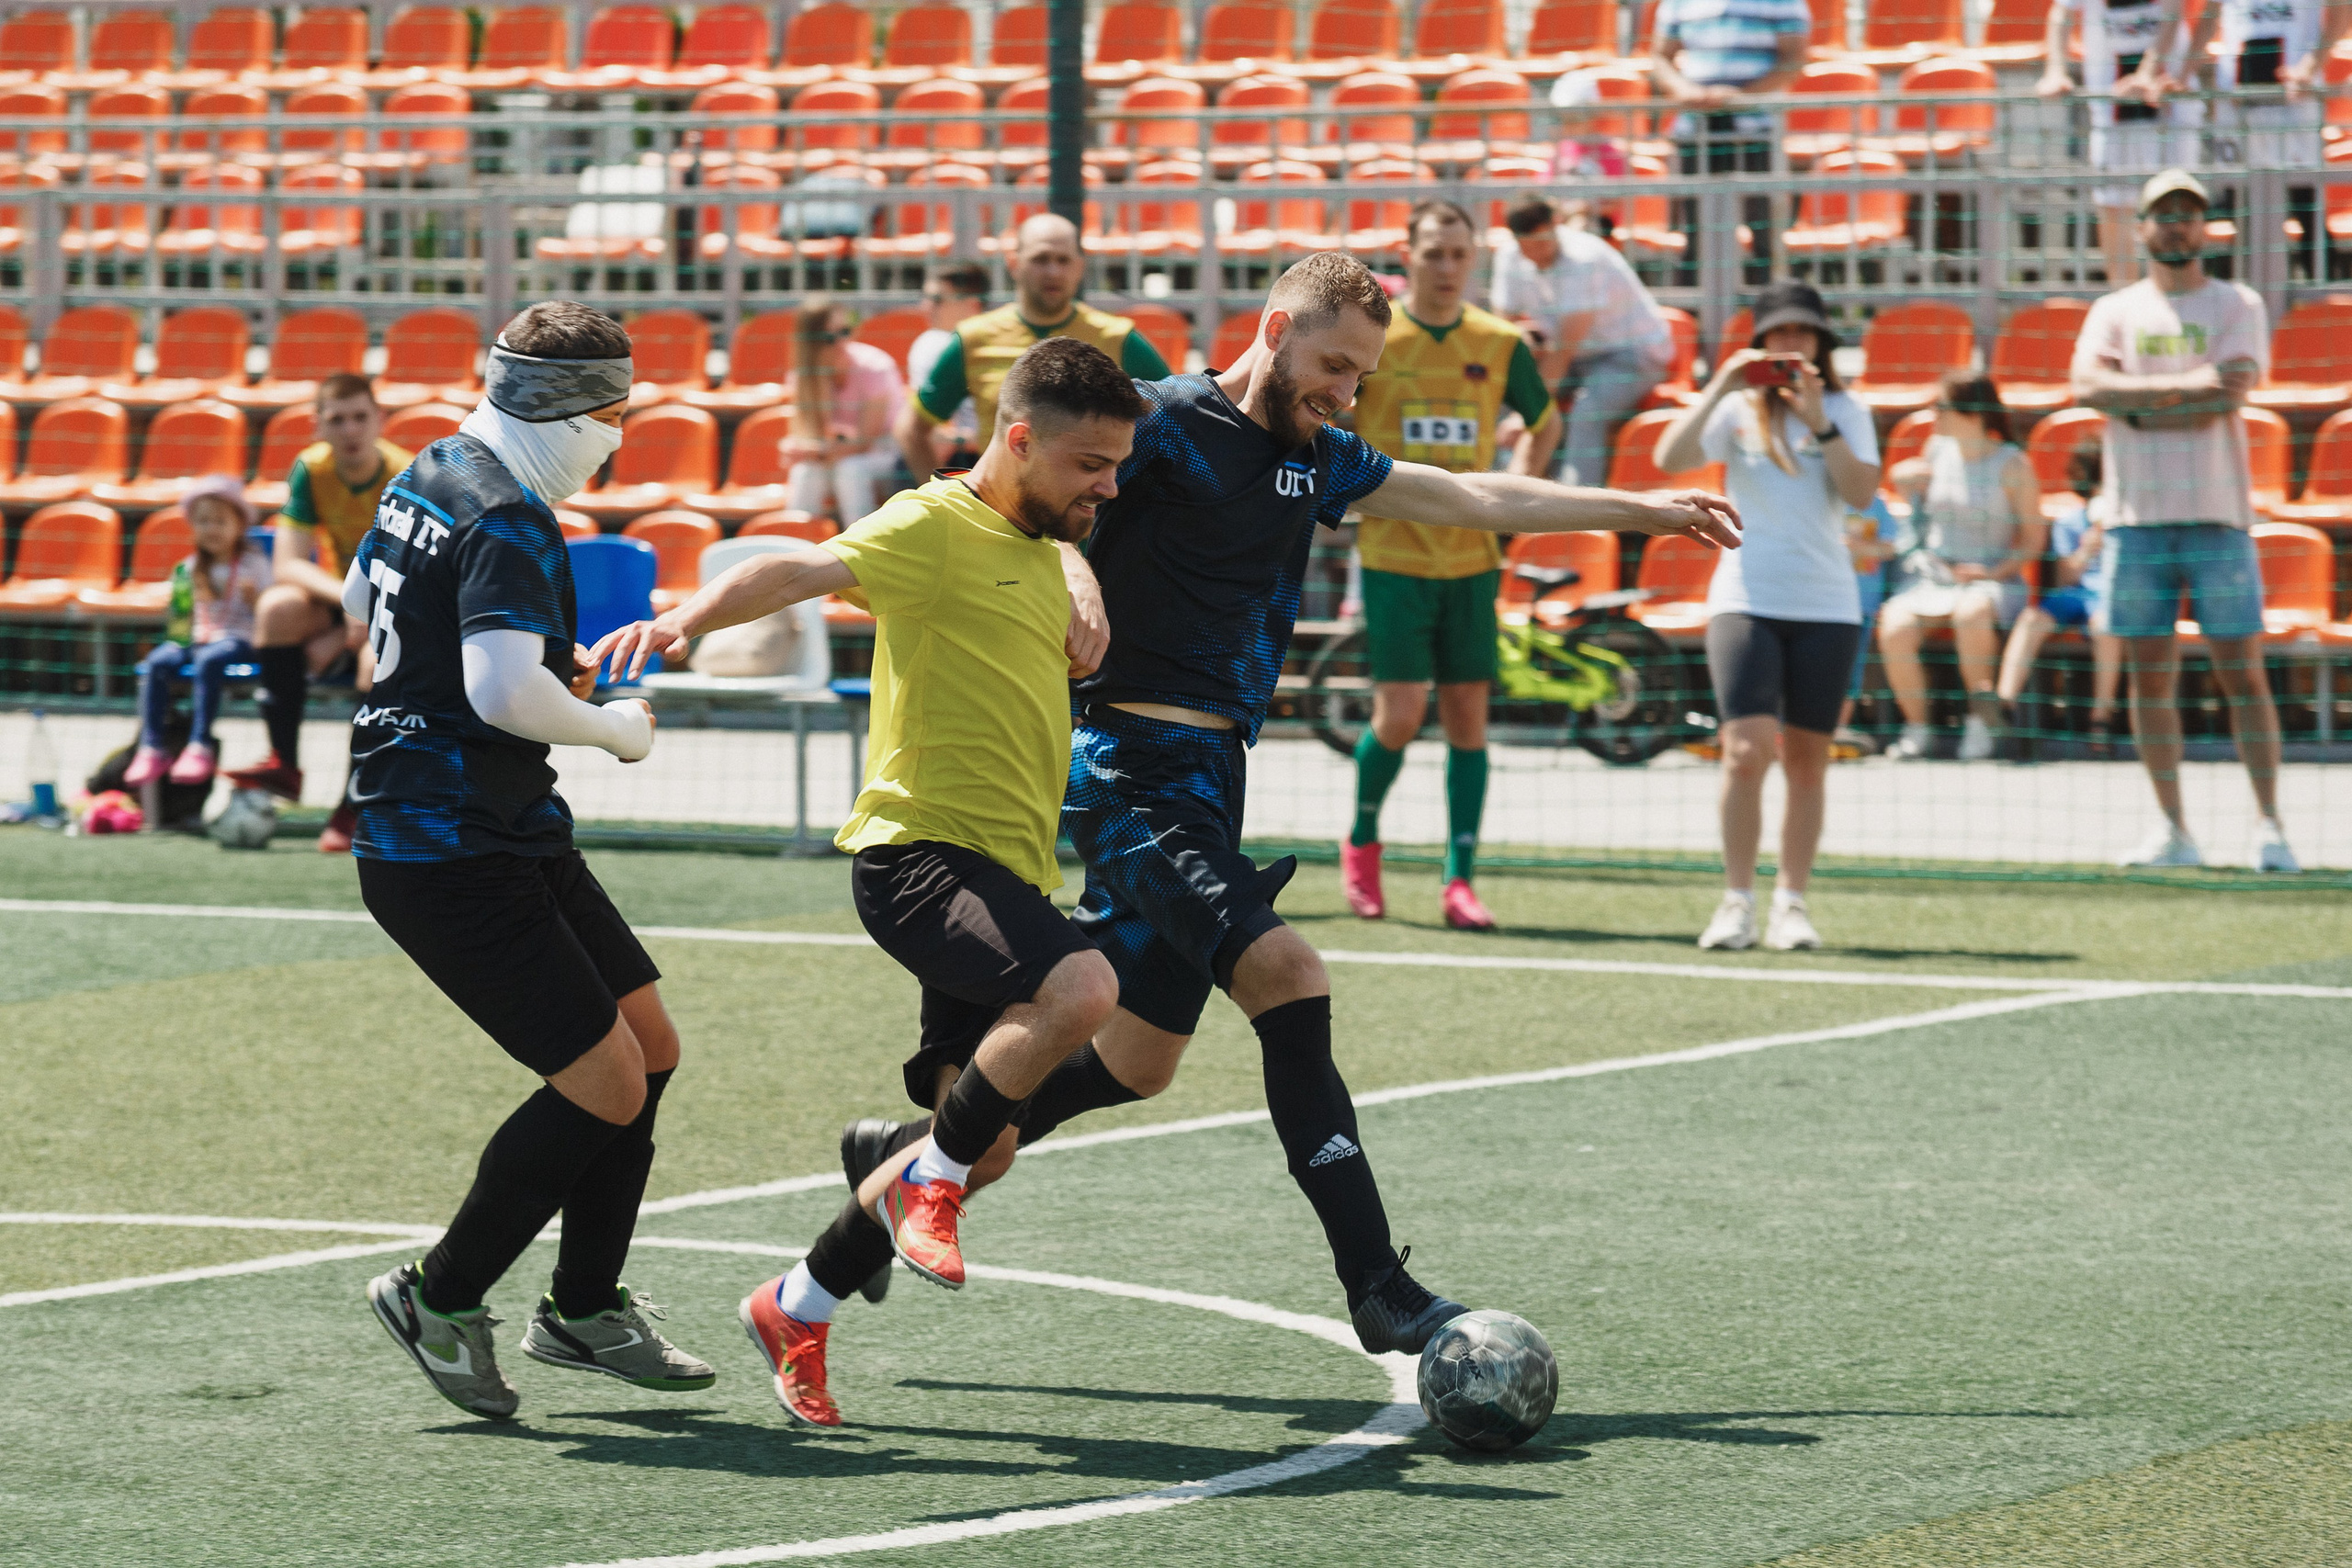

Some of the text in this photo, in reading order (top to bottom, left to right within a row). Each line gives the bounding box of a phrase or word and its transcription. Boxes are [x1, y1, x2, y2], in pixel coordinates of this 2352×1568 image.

[1275, 468, 1317, 497] UIT
[413, 514, 450, 557] IT
[1308, 1145, 1360, 1168] adidas
